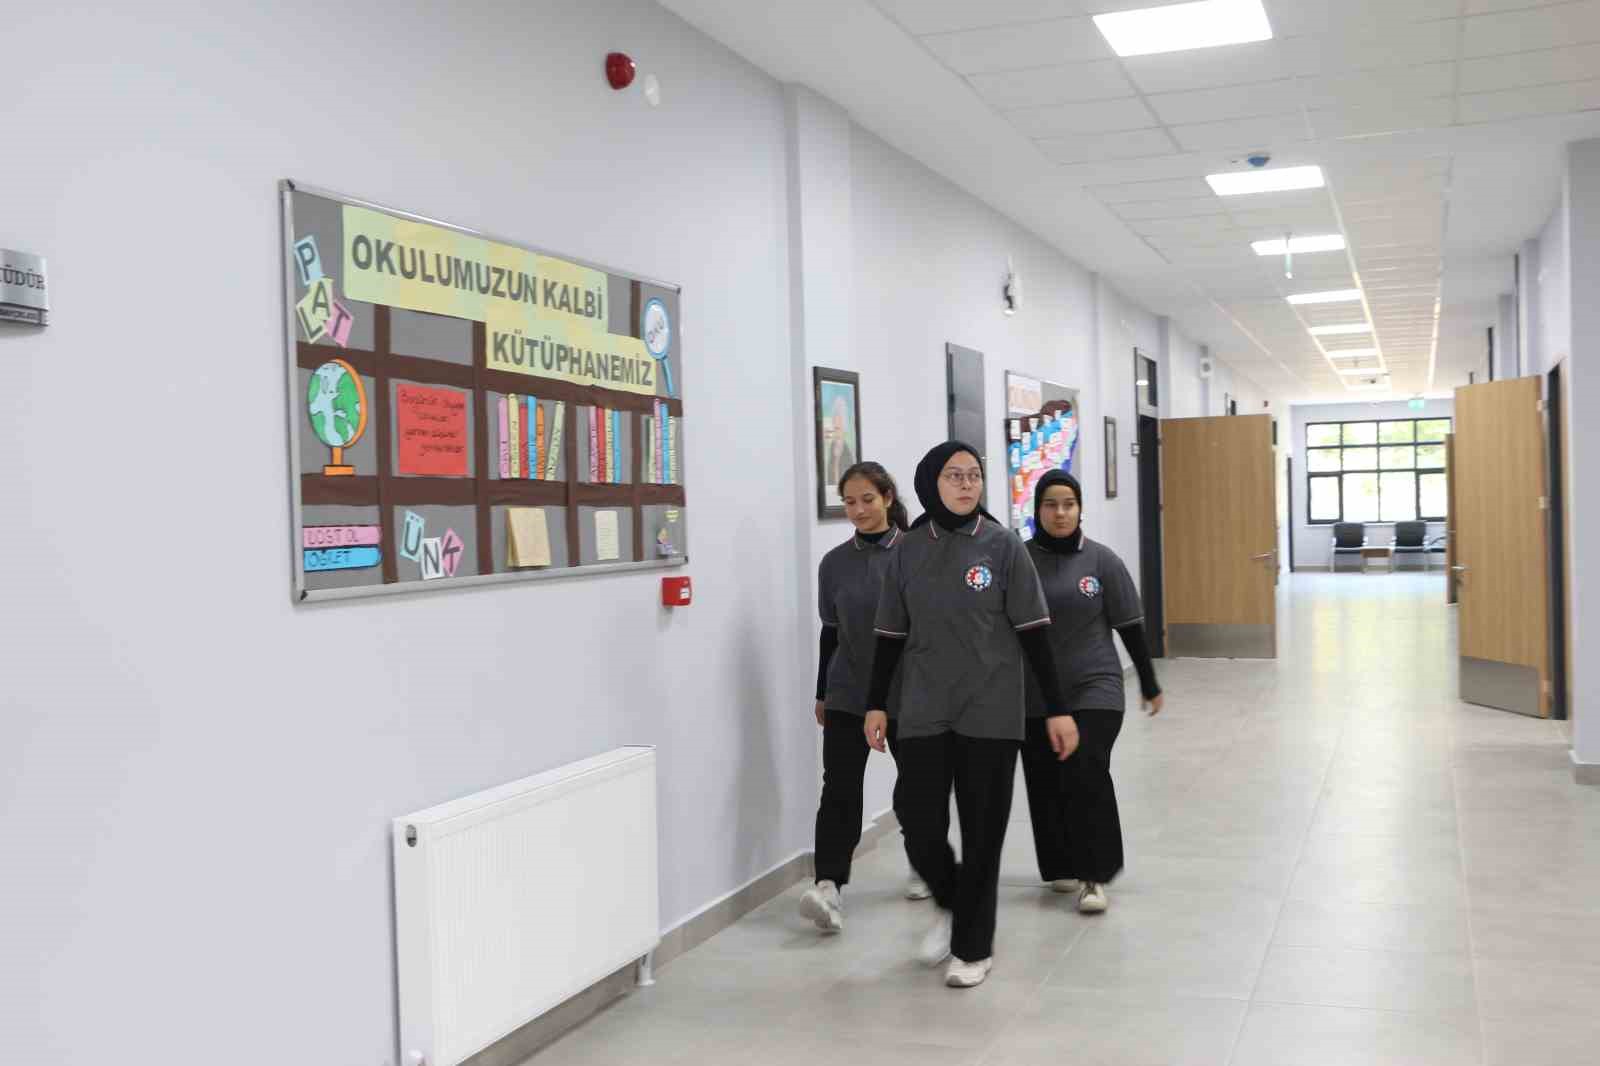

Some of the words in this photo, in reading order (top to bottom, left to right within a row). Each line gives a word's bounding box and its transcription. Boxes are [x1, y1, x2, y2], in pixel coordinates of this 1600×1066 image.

[0, 263, 46, 290] ÜDÜR
[352, 234, 537, 305] OKULUMUZUN
[543, 279, 603, 320] KALBİ
[493, 328, 653, 386] KÜTÜPHANEMİZ
